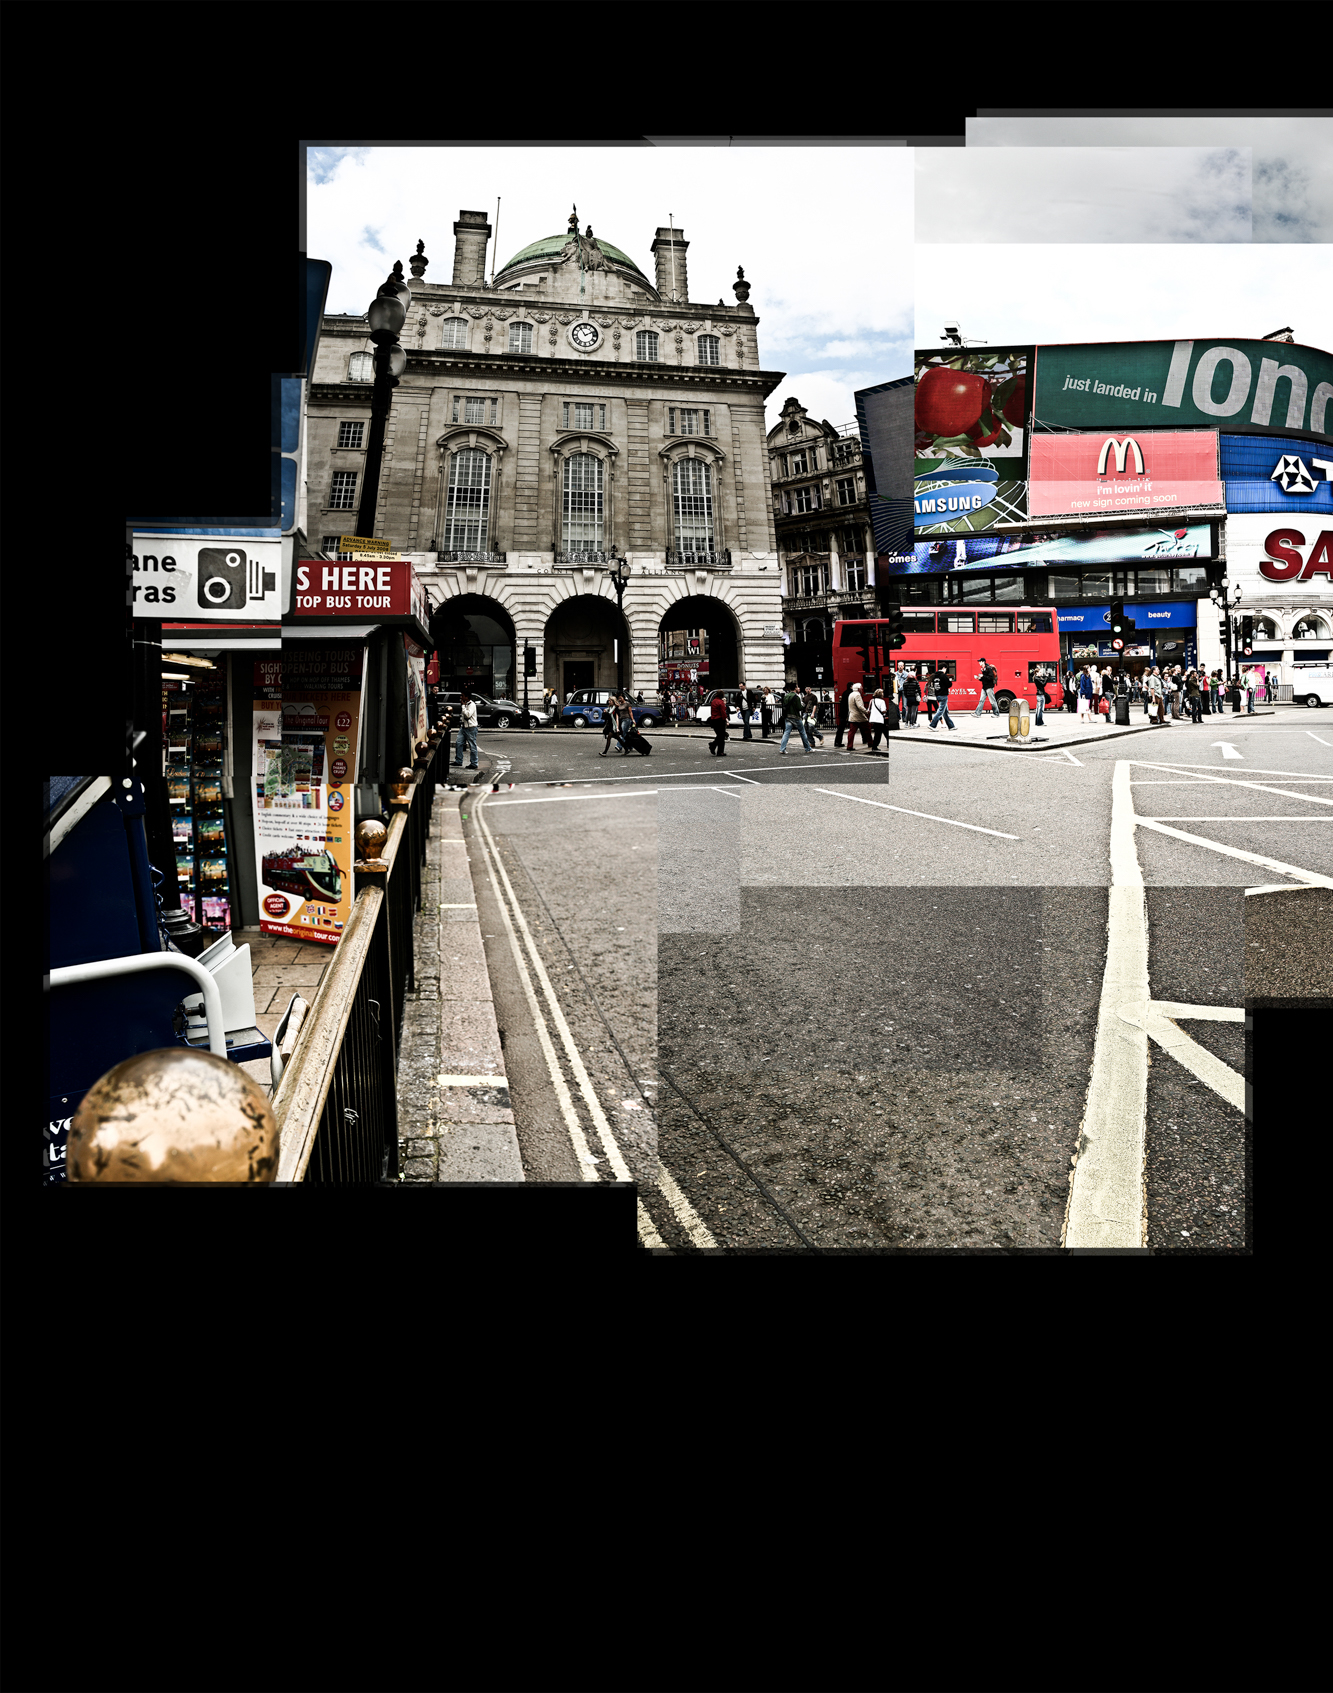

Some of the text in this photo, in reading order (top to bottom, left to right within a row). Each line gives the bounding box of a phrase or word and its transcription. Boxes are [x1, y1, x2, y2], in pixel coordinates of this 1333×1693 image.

[1062, 375, 1091, 392] just
[1093, 380, 1141, 400] landed
[1143, 388, 1157, 404] in
[1097, 486, 1112, 495] i'm
[1144, 482, 1152, 491] it
[1093, 498, 1112, 508] sign
[1115, 495, 1150, 505] coming
[889, 555, 917, 563] omes
[296, 566, 391, 590] S HERE
[296, 596, 391, 608] TOP BUS TOUR
[330, 662, 349, 673] BUS
[265, 674, 275, 684] BY
[299, 692, 328, 701] TICKETS
[331, 692, 351, 701] HERE
[295, 716, 315, 726] Original
[337, 719, 350, 727] £22
